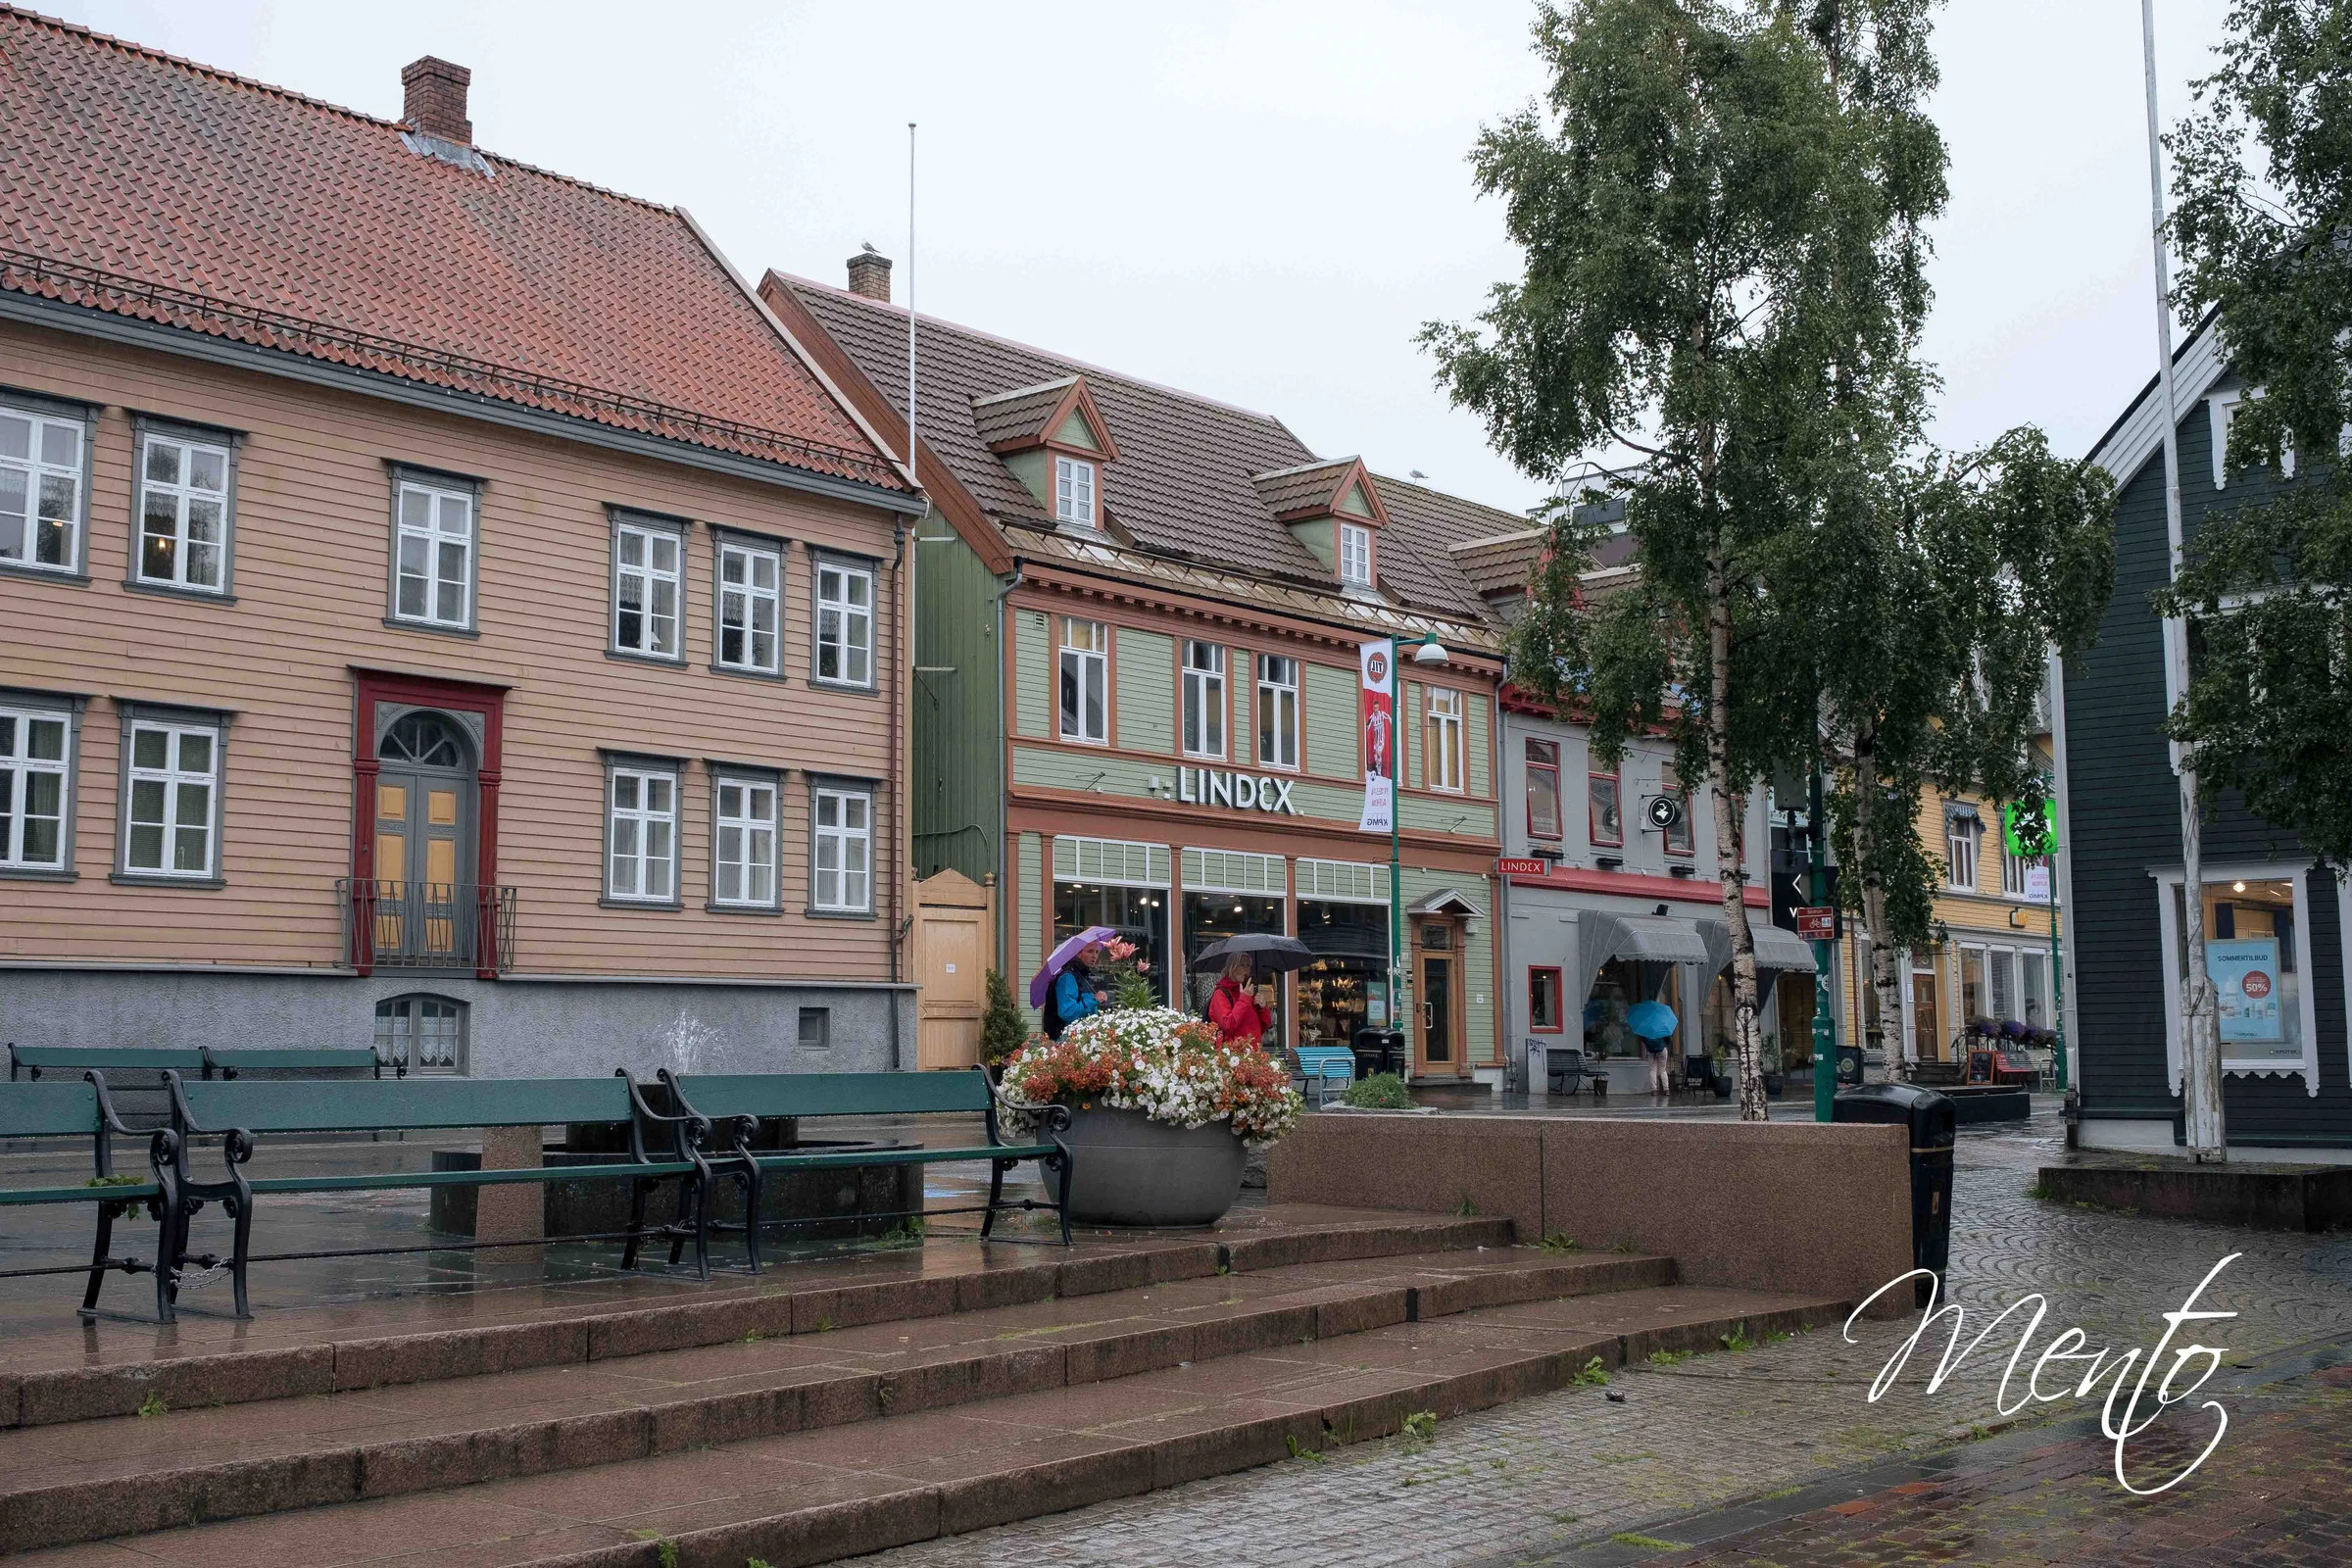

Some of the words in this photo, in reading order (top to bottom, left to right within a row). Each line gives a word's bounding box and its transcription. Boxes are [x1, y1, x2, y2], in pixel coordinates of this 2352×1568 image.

[1179, 765, 1297, 815] LINDEX
[1500, 861, 1541, 872] LINDEX
[2245, 983, 2268, 993] 50%
